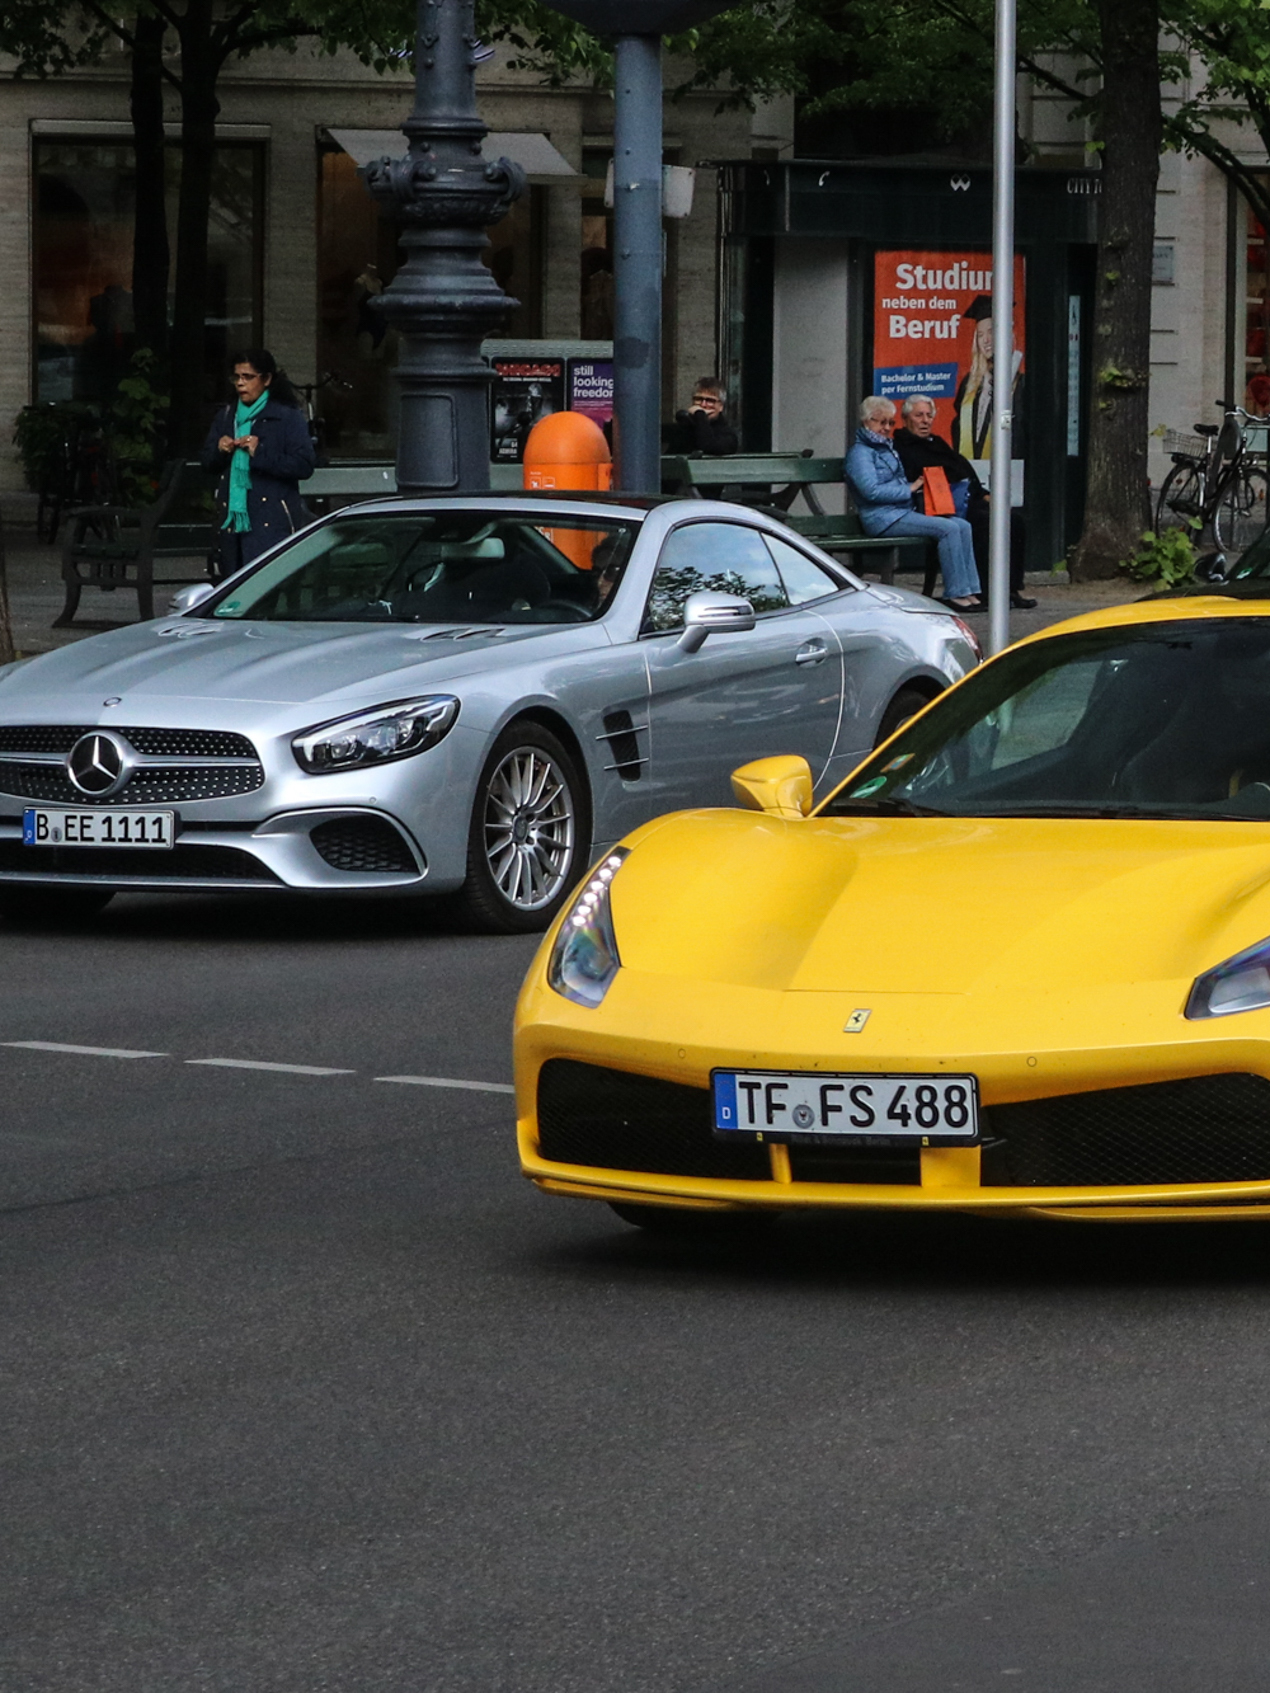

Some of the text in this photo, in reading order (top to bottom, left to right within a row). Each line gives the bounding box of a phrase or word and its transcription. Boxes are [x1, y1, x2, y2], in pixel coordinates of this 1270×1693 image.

[1066, 178, 1092, 194] CITY
[882, 296, 956, 309] neben dem
[889, 314, 961, 339] Beruf
[573, 365, 594, 376] still
[881, 373, 915, 383] Bachelor
[925, 371, 951, 380] Master
[881, 383, 944, 395] per Fernstudium
[37, 814, 49, 840] B
[64, 815, 95, 842] EE
[101, 816, 167, 843] 1111
[722, 1081, 969, 1129] D TF FS 488
